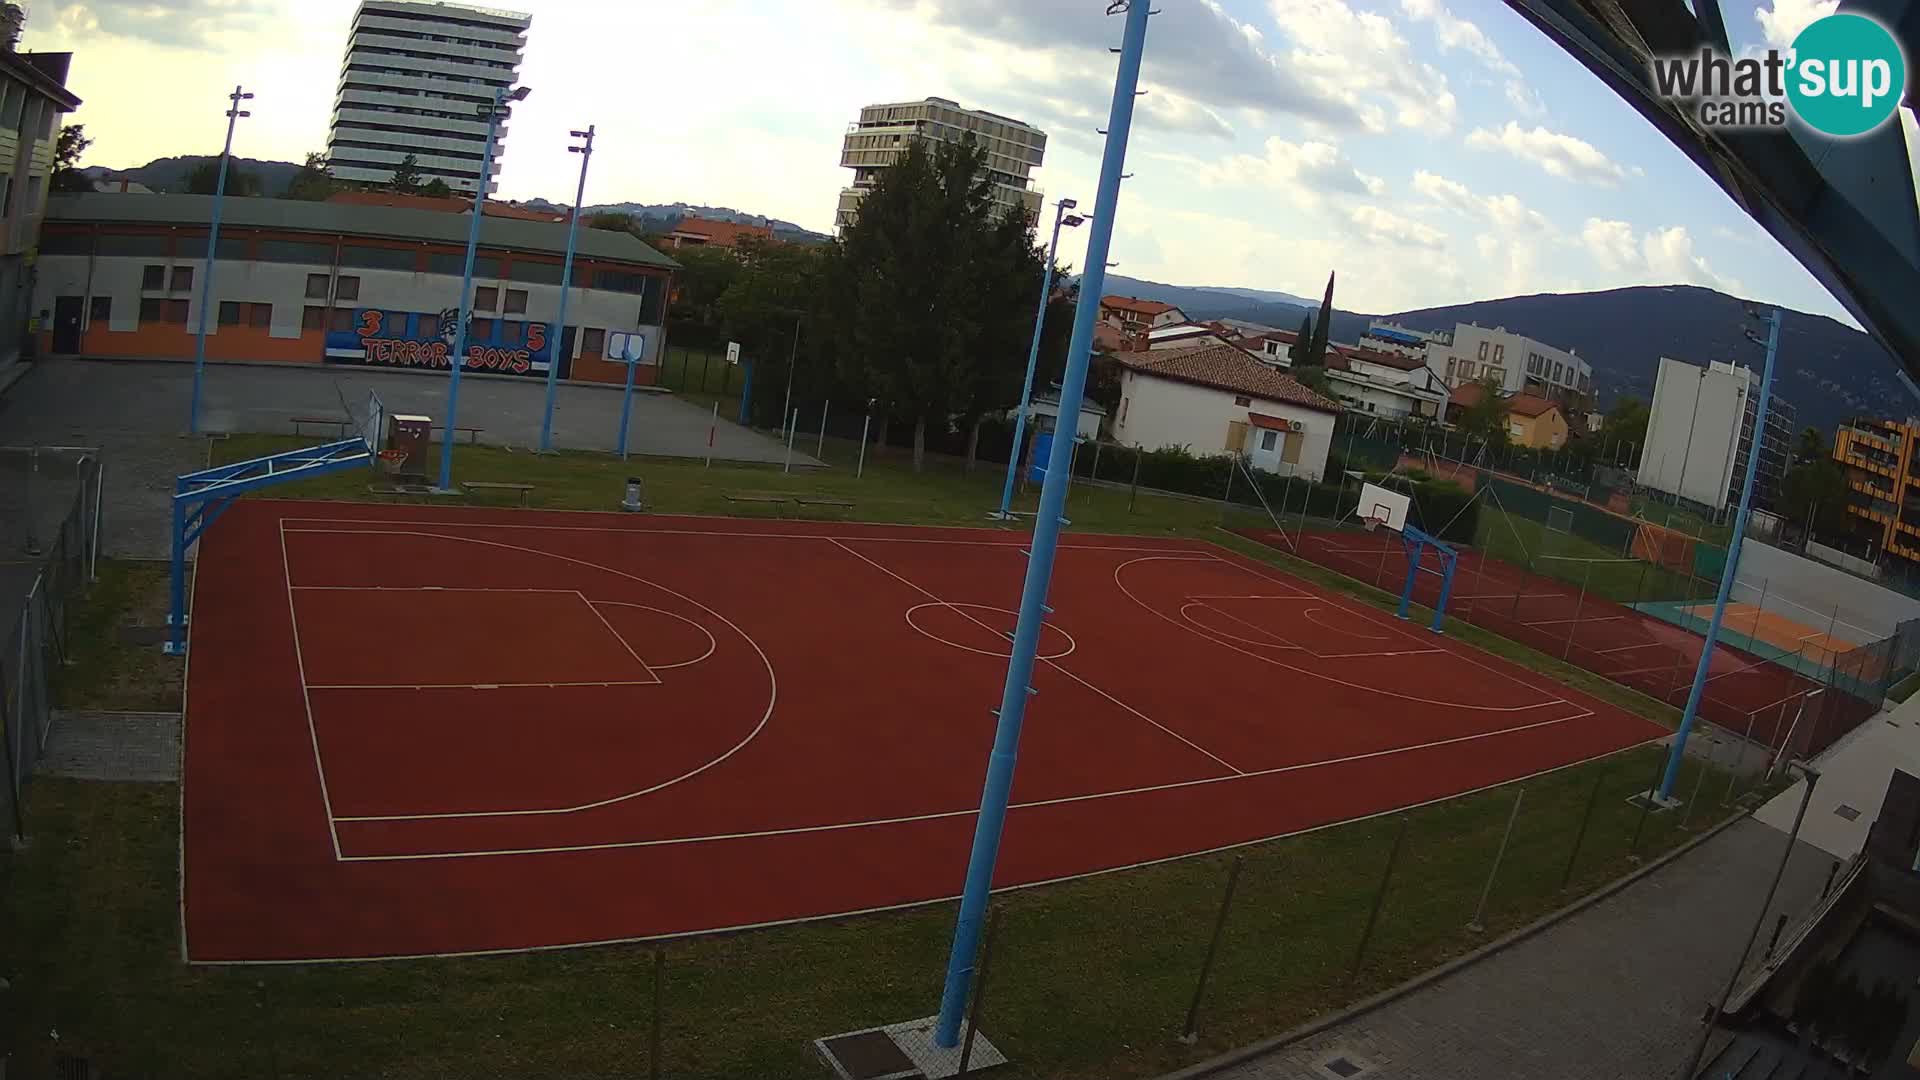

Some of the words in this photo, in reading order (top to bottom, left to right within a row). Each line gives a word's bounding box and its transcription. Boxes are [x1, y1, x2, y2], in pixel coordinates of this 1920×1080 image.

[357, 310, 383, 337] 3
[526, 323, 547, 351] 5
[362, 338, 449, 367] TERROR
[467, 345, 530, 374] BOYS
